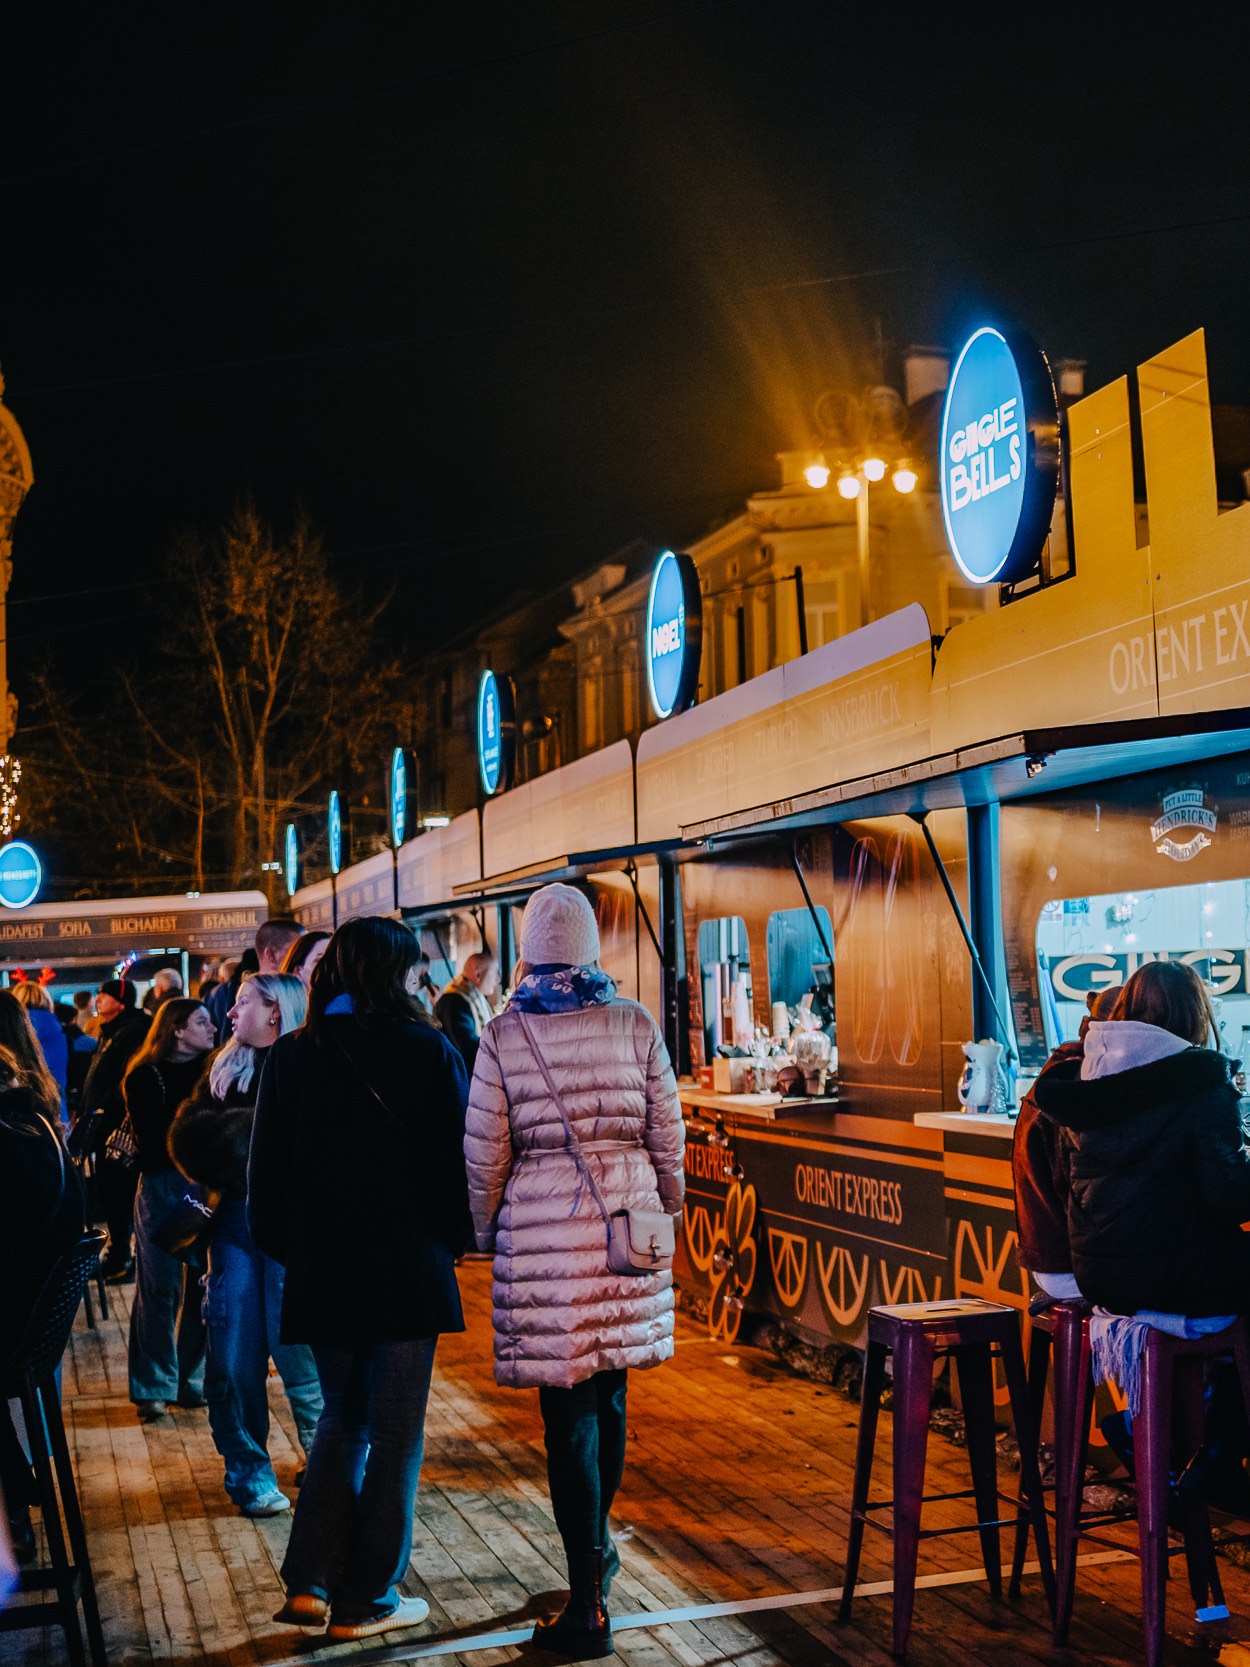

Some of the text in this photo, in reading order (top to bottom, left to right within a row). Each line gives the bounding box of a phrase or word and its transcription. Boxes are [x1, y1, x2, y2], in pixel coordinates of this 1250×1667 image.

[950, 433, 1021, 512] BELLS
[652, 617, 681, 659] NOEL
[1109, 614, 1206, 695] ORIENT
[821, 681, 901, 745] INNSBRUCK
[1155, 809, 1214, 837] HENDRICK'S
[1181, 793, 1202, 804] LITTLE
[111, 916, 177, 934] BUCHAREST
[203, 911, 257, 930] ISTANBUL
[795, 1164, 903, 1226] ORIENT EXPRESS
